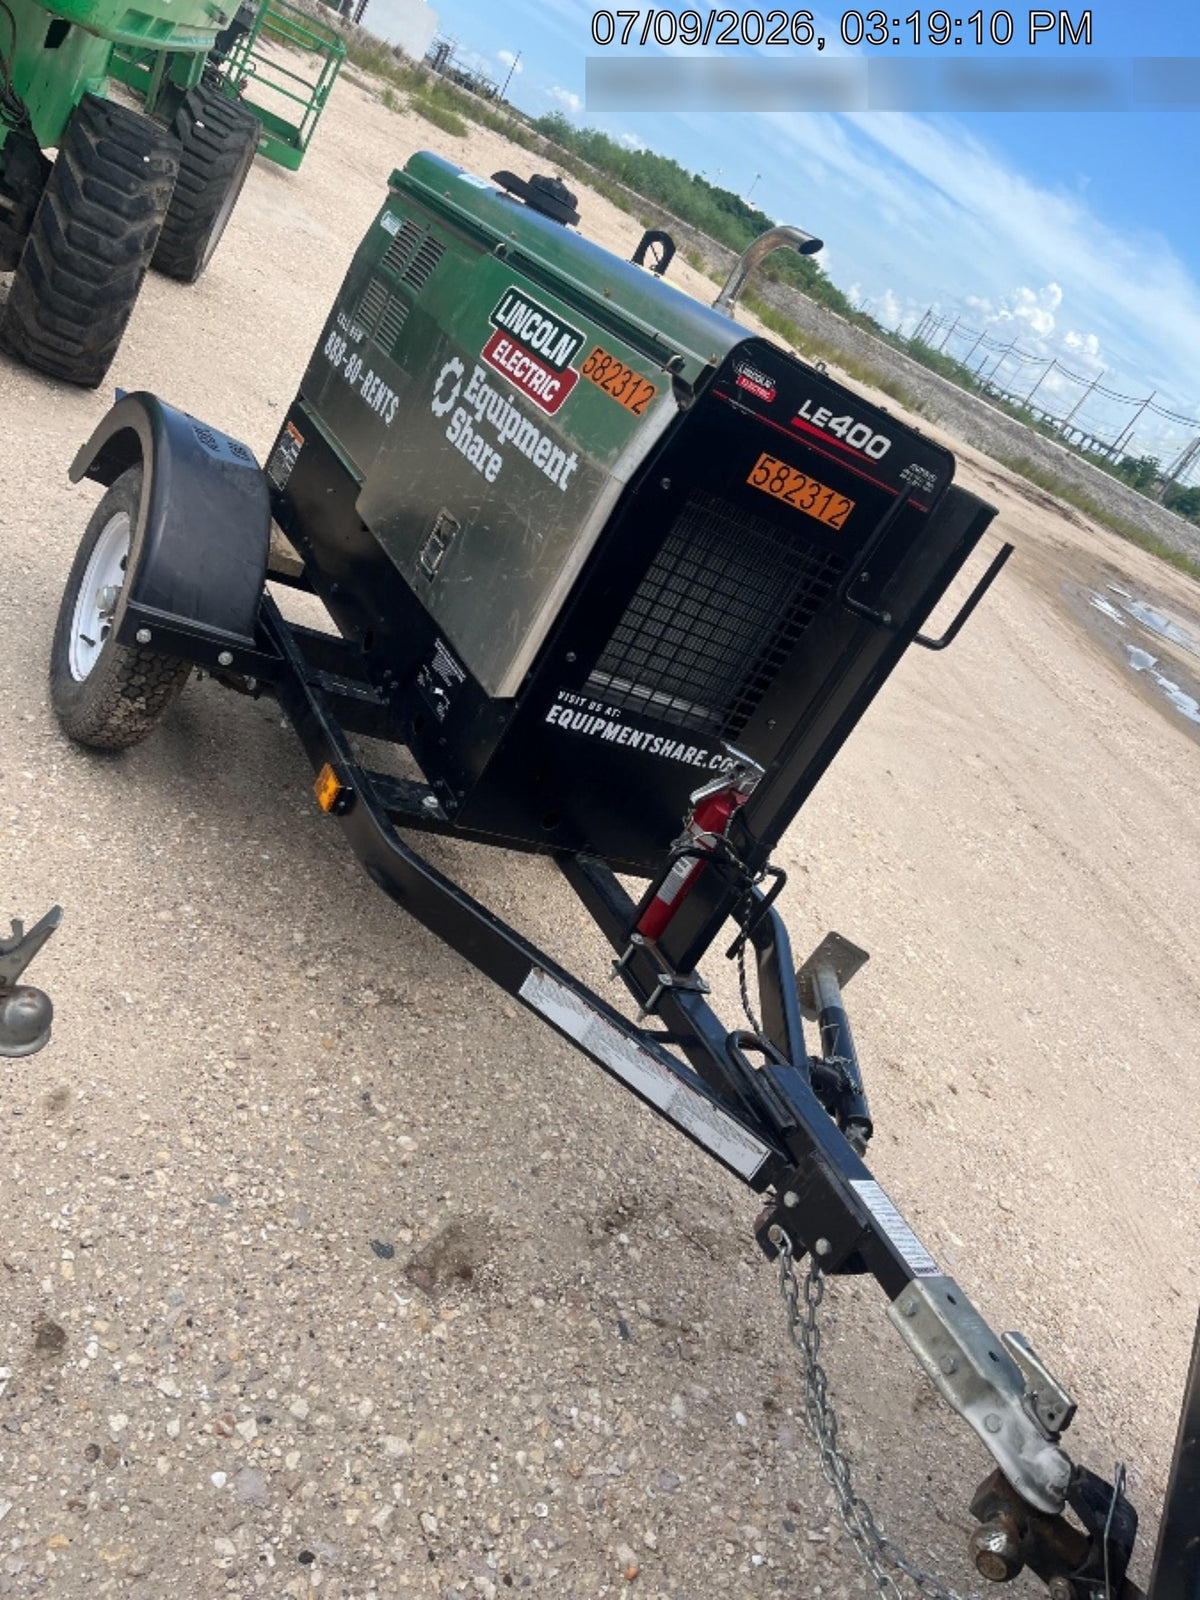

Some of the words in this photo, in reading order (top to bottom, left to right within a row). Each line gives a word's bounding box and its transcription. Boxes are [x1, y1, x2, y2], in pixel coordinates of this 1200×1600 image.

[495, 295, 577, 367] LINCOLN
[492, 340, 561, 402] ELECTRIC
[582, 347, 656, 414] 582312
[446, 406, 502, 482] Share
[463, 364, 578, 491] Equipment
[797, 399, 892, 460] LE400
[753, 456, 850, 528] 582312
[557, 690, 587, 706] VISIT
[545, 704, 740, 773] EQUIPMENTSHARE.CO
